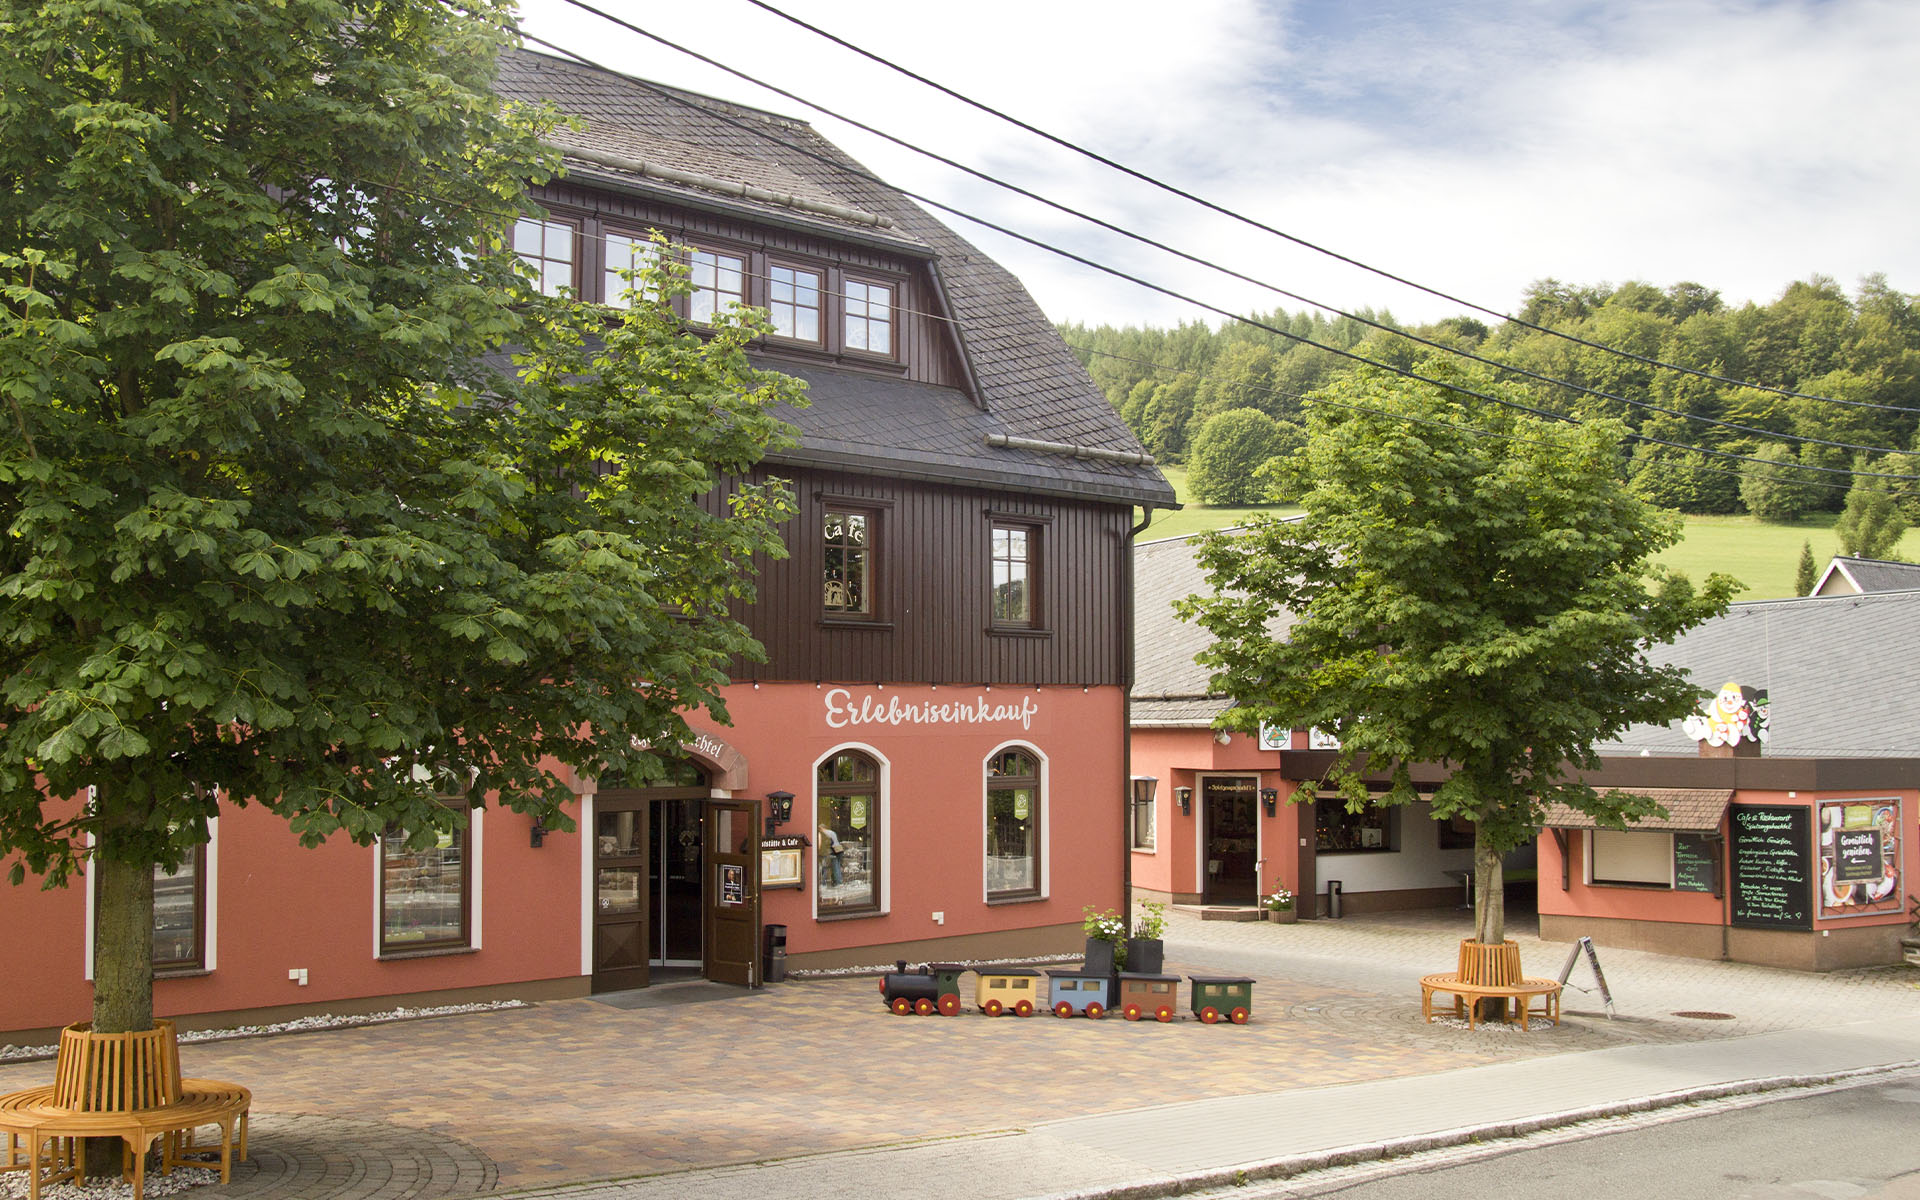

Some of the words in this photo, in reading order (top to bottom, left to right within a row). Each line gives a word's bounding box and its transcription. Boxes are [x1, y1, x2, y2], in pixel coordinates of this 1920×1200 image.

[824, 688, 1038, 731] Erlebniseinkauf
[1758, 811, 1792, 822] Restaurant
[1841, 833, 1873, 846] Gemütlich
[1842, 846, 1873, 859] genießen.
